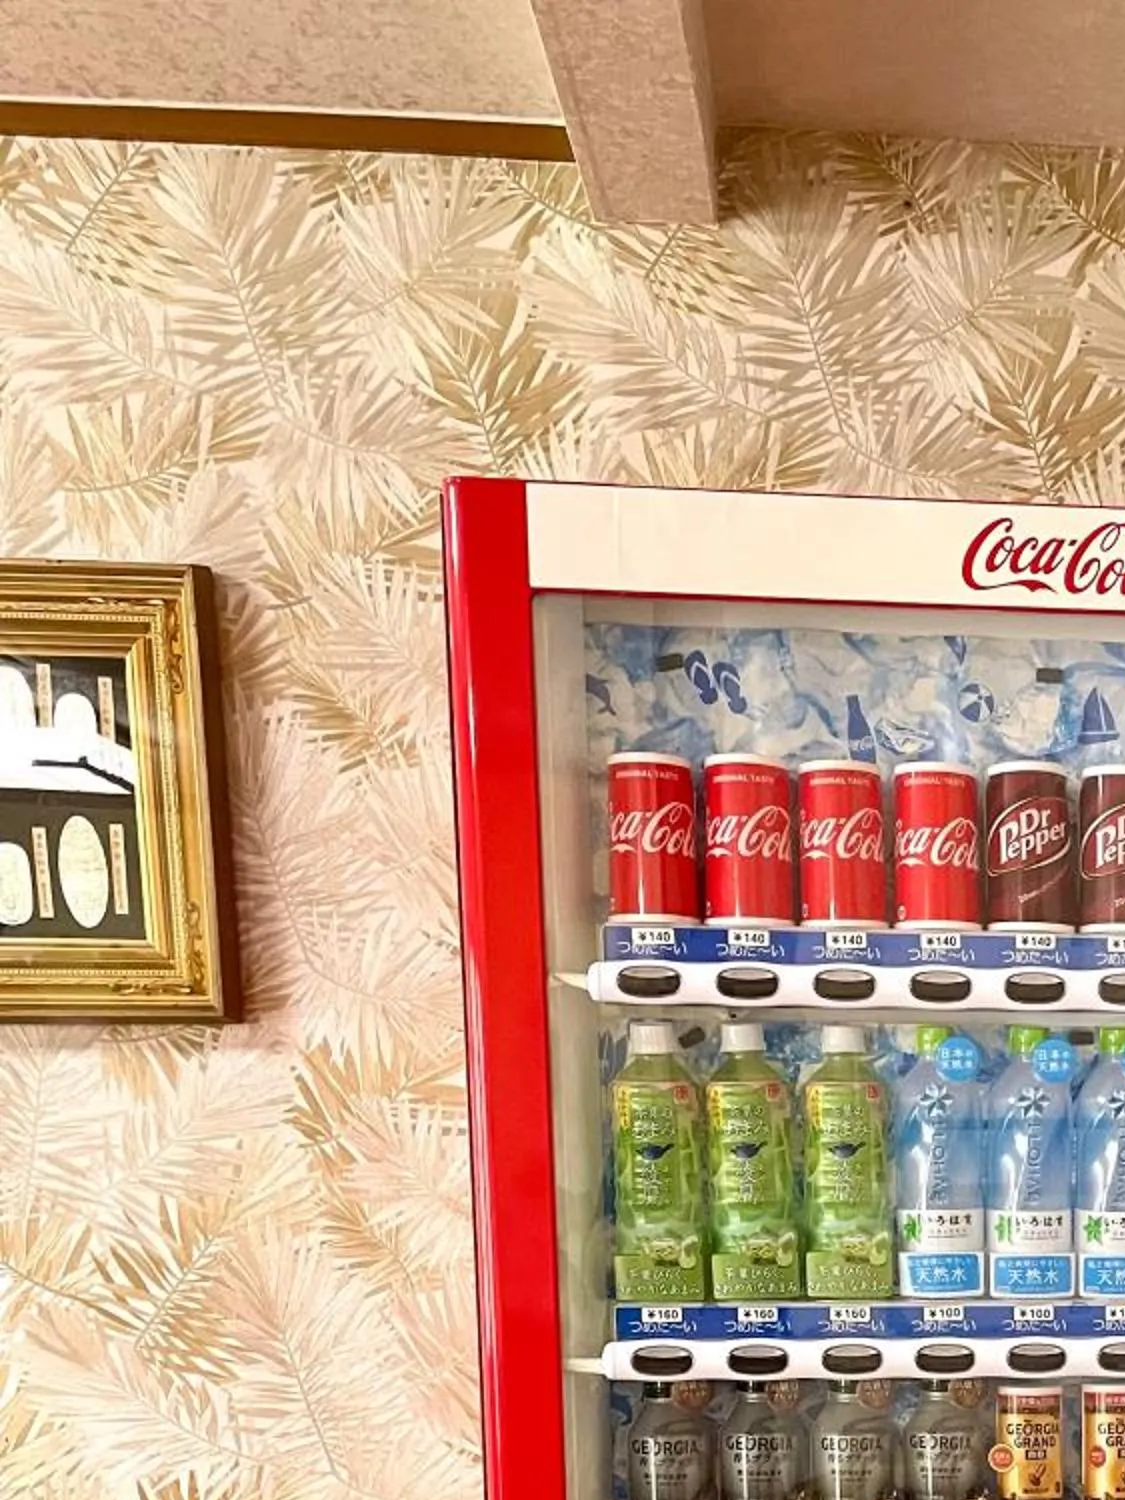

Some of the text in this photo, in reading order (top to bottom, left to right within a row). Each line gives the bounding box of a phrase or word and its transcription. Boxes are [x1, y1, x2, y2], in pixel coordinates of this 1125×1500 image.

[1019, 808, 1052, 833] Dr
[999, 821, 1066, 865] Pepper
[639, 933, 671, 942] ¥140
[734, 934, 765, 943] ¥140
[831, 935, 863, 944] ¥140
[926, 936, 957, 945] ¥140
[1022, 937, 1051, 946] ¥140
[916, 1267, 968, 1284] 天然水
[1008, 1268, 1059, 1285] 天然水
[647, 1310, 678, 1319] ¥160
[743, 1310, 774, 1319] ¥160
[834, 1309, 866, 1318] ¥160
[929, 1308, 960, 1318] ¥100
[1020, 1308, 1051, 1318] ¥100
[632, 1438, 699, 1456] GEORGIA
[726, 1434, 793, 1451] GEORGIA
[821, 1436, 882, 1451] GEORGIA
[909, 1434, 972, 1450] GEORGIA
[1014, 1435, 1057, 1449] GRAND
